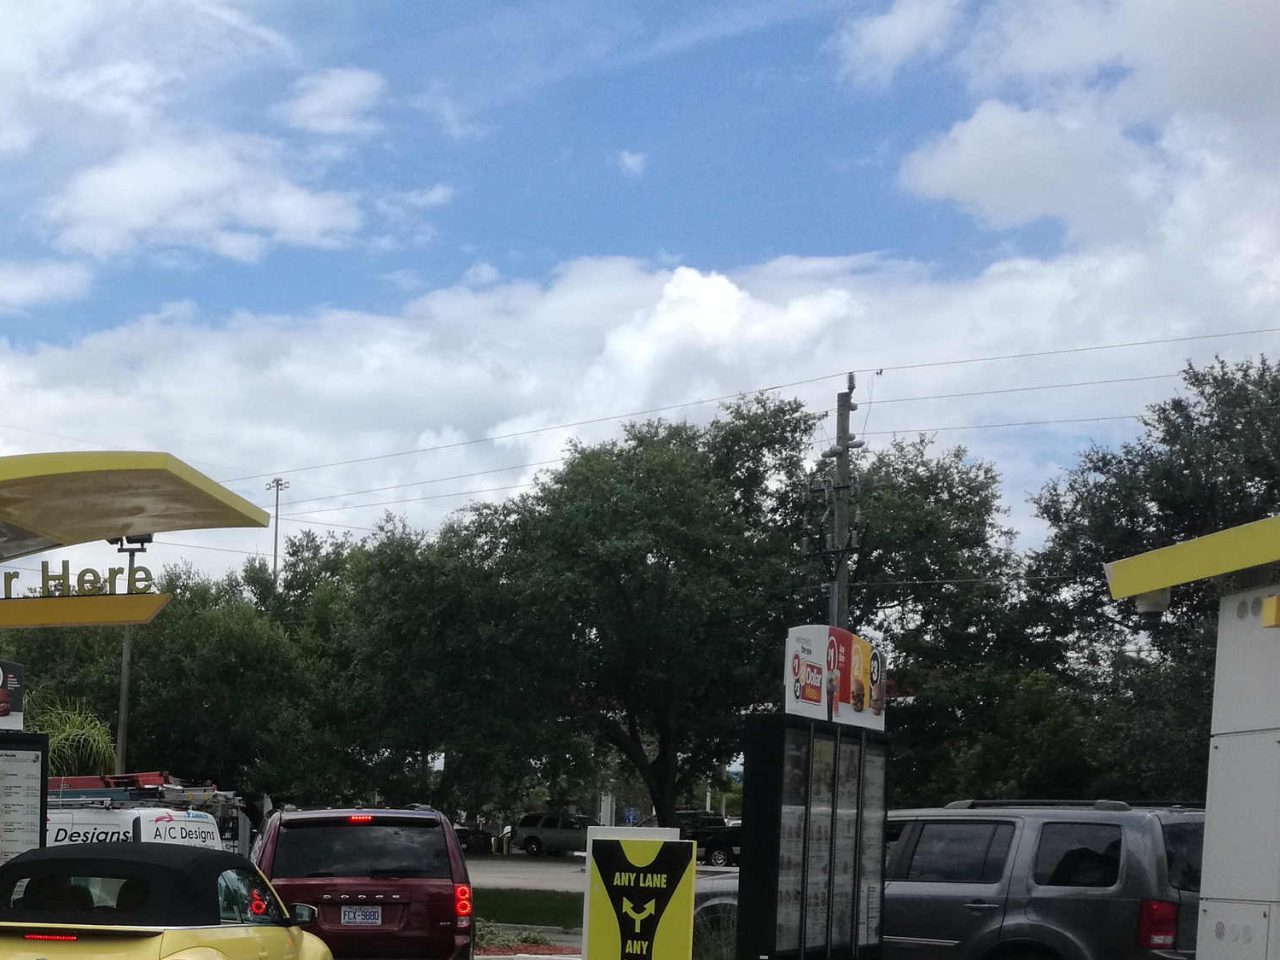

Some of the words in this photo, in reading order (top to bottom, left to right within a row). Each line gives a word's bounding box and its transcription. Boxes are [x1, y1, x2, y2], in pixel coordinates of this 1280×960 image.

[41, 559, 154, 597] Here
[54, 827, 130, 843] Designs
[154, 827, 177, 841] A/C
[180, 827, 215, 843] Designs
[613, 872, 637, 887] ANY
[639, 873, 668, 889] LANE
[625, 940, 649, 955] ANY
